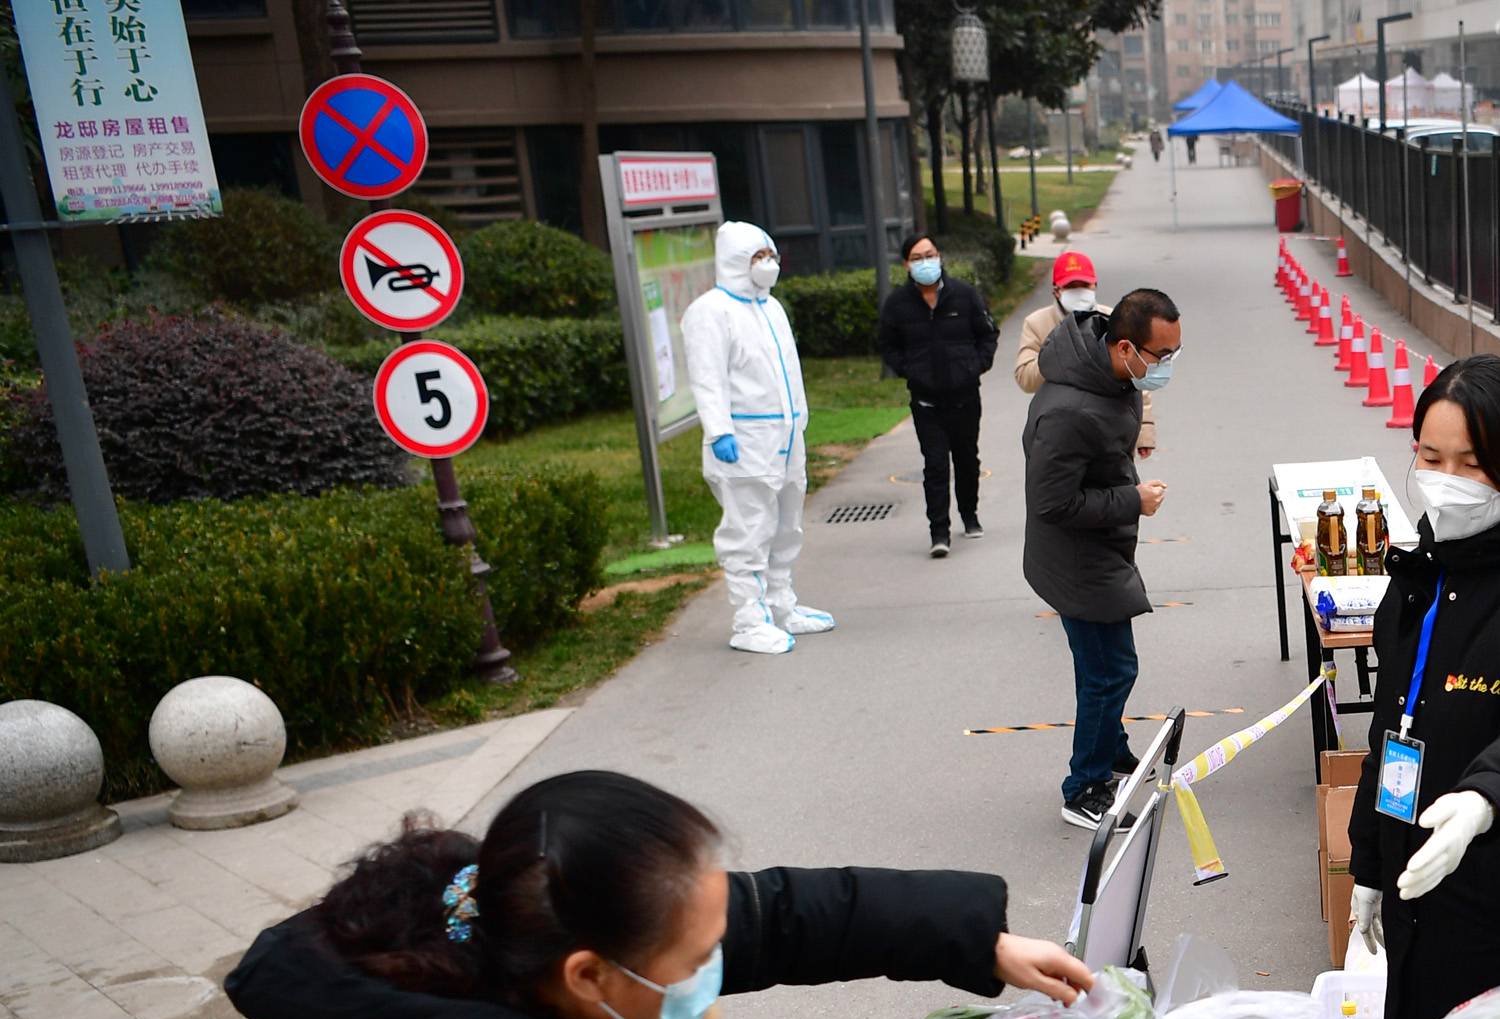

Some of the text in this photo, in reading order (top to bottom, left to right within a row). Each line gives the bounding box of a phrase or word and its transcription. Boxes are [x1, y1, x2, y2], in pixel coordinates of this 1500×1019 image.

[54, 116, 189, 139] 龙邸房屋租售
[60, 141, 195, 161] 房源登记 房产交易
[63, 160, 200, 181] 租赁代理 代办手续
[415, 368, 452, 429] 5
